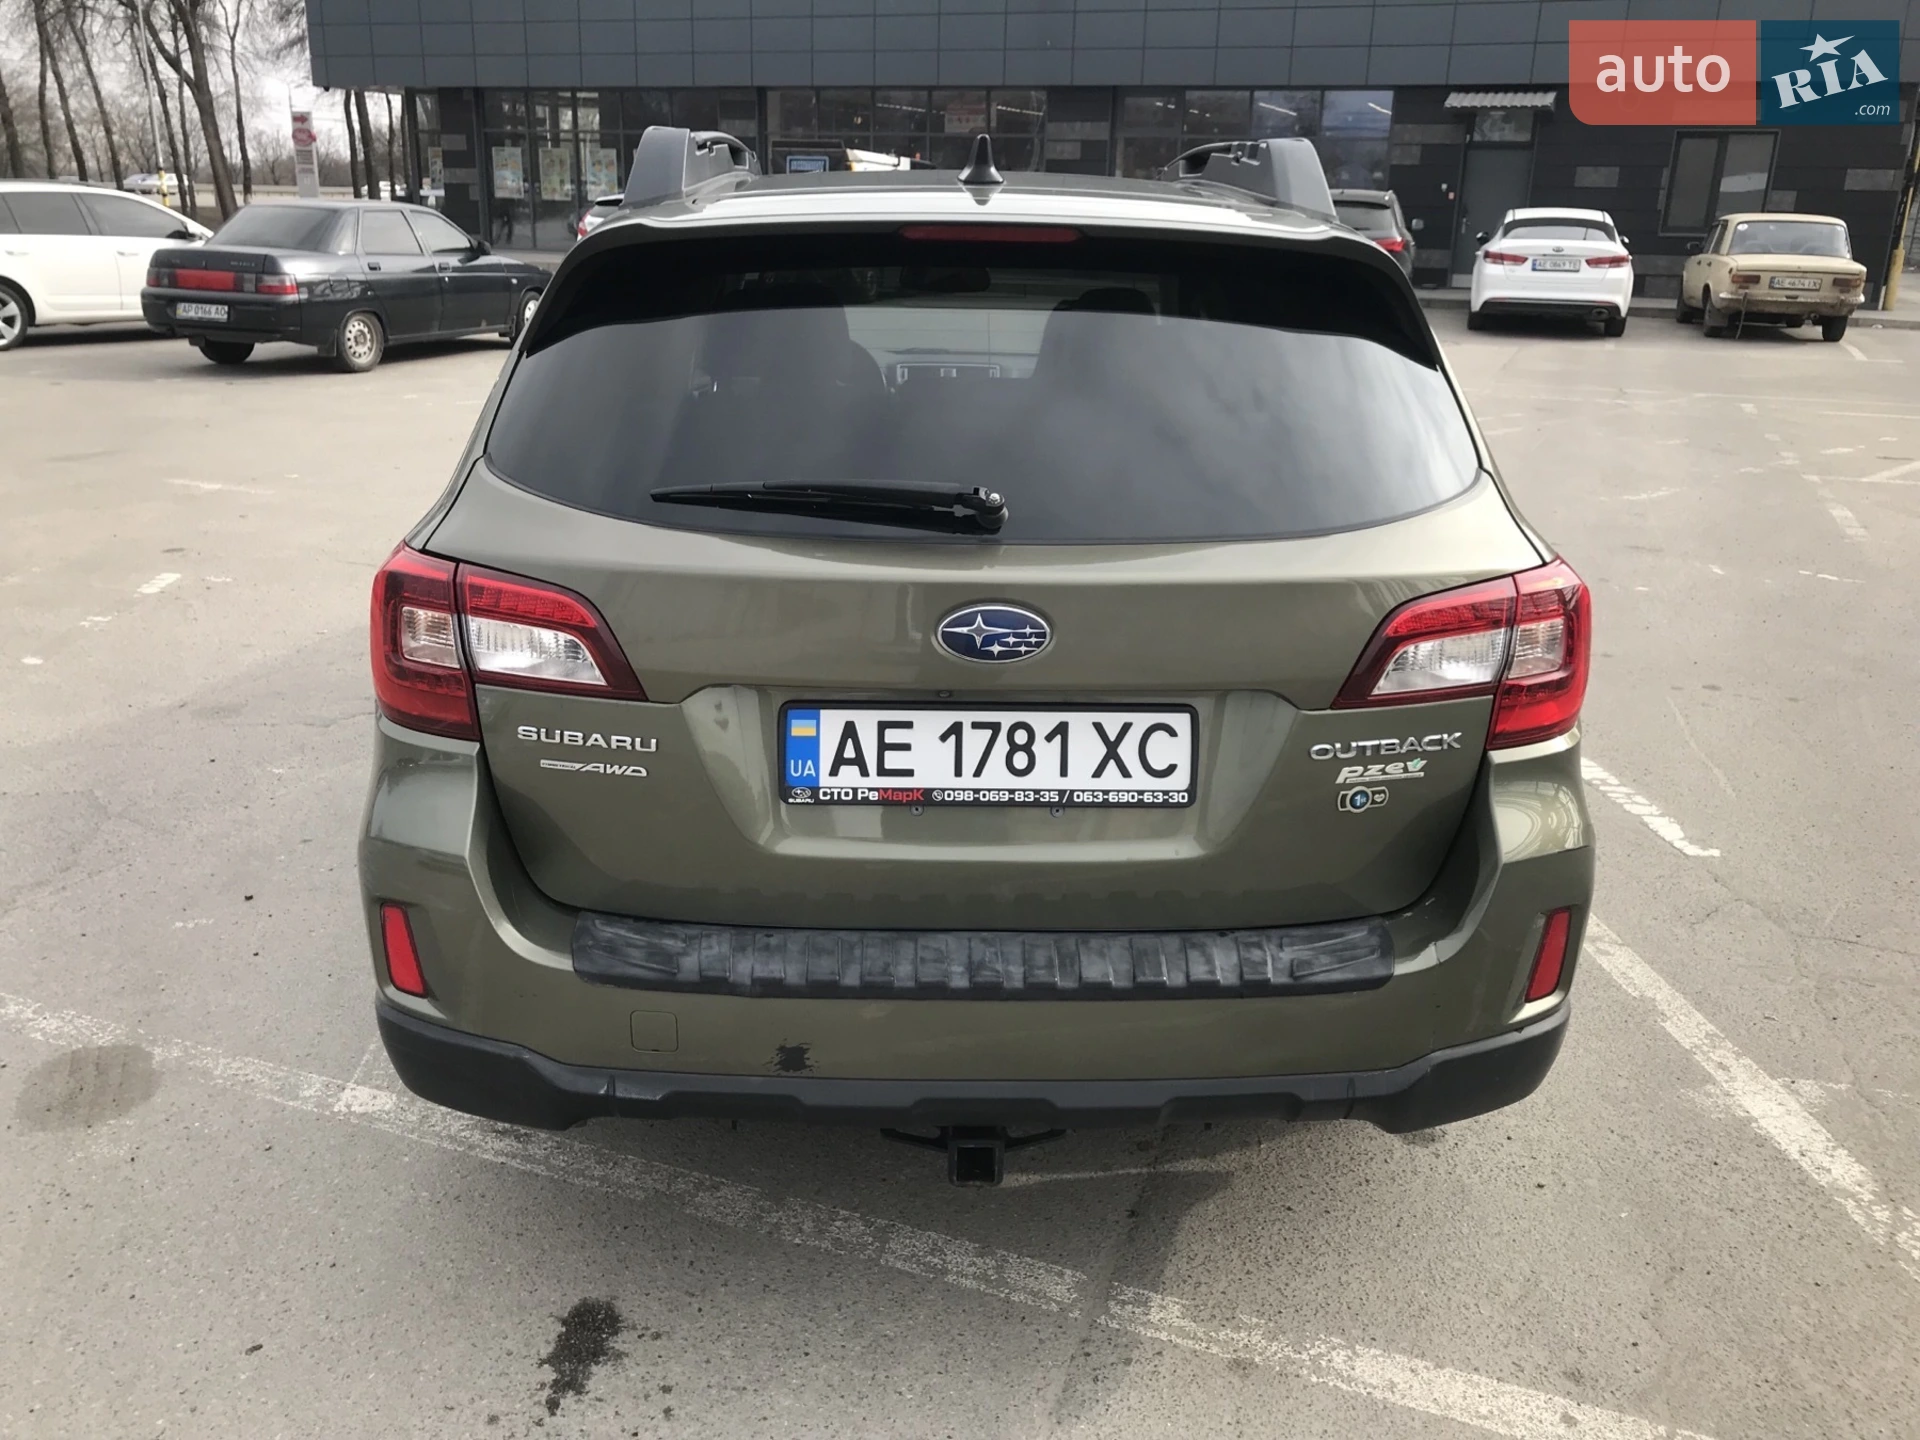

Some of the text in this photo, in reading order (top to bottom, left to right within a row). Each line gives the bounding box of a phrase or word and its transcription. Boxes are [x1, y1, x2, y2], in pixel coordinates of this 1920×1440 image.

[182, 304, 192, 313] AP
[194, 305, 213, 316] 0166
[517, 725, 657, 752] SUBARU
[1310, 732, 1462, 760] OUTBACK
[828, 720, 1179, 779] AE 1781 XC
[579, 763, 648, 777] AWD
[790, 759, 816, 777] UA
[818, 788, 853, 800] СТО
[944, 790, 1059, 802] 098-069-83-35
[1073, 791, 1189, 803] 063-690-63-30
